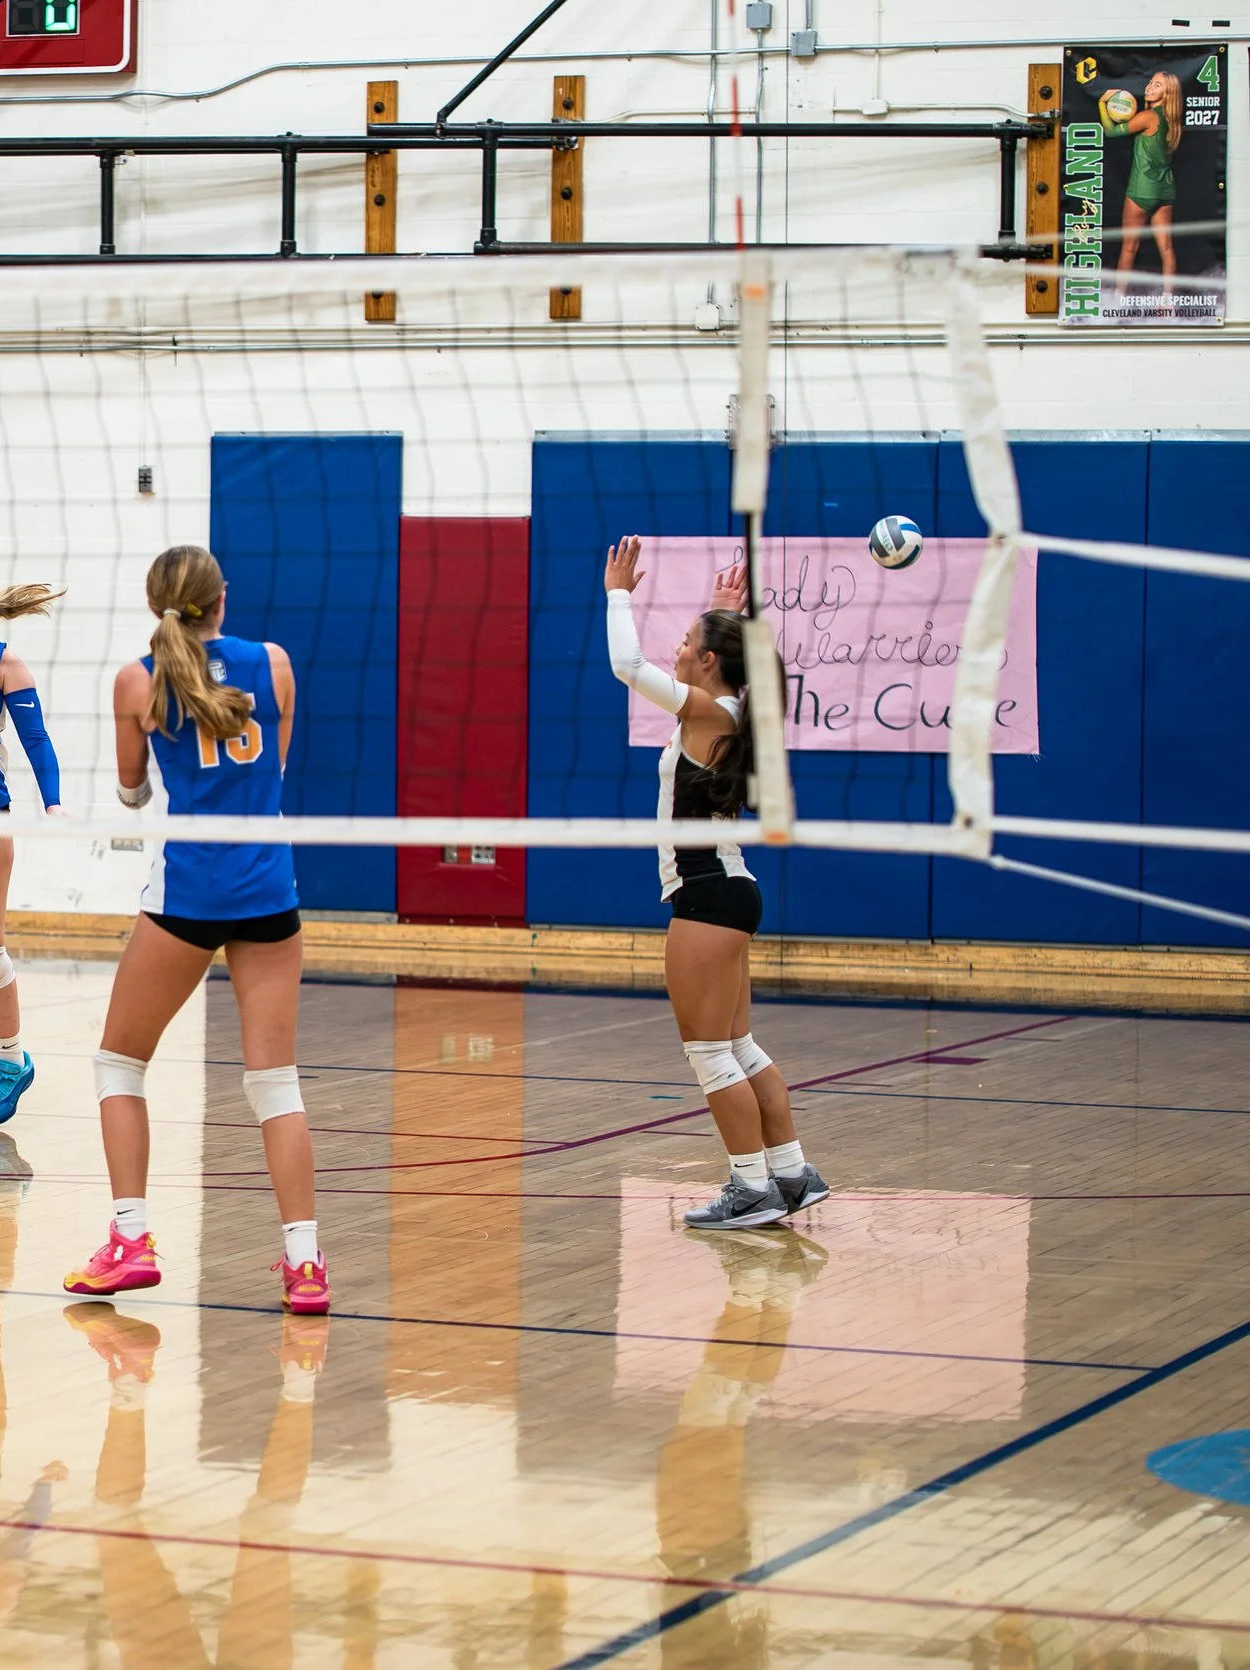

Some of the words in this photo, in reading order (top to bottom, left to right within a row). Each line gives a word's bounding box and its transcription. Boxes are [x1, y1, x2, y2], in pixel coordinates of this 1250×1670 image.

[1196, 56, 1220, 92] 4
[1186, 96, 1221, 107] SENIOR
[1185, 110, 1221, 126] 2027
[1064, 122, 1103, 318] HIGHLAND
[1102, 308, 1142, 318] CLEVELAND
[1143, 308, 1173, 317] VARSITY
[1174, 307, 1216, 317] VOLLEYBALL
[1120, 295, 1167, 306] DEFENSIVE
[1168, 295, 1218, 306] SPECIALIST
[716, 545, 857, 631] ady
[874, 683, 1017, 731] Cue
